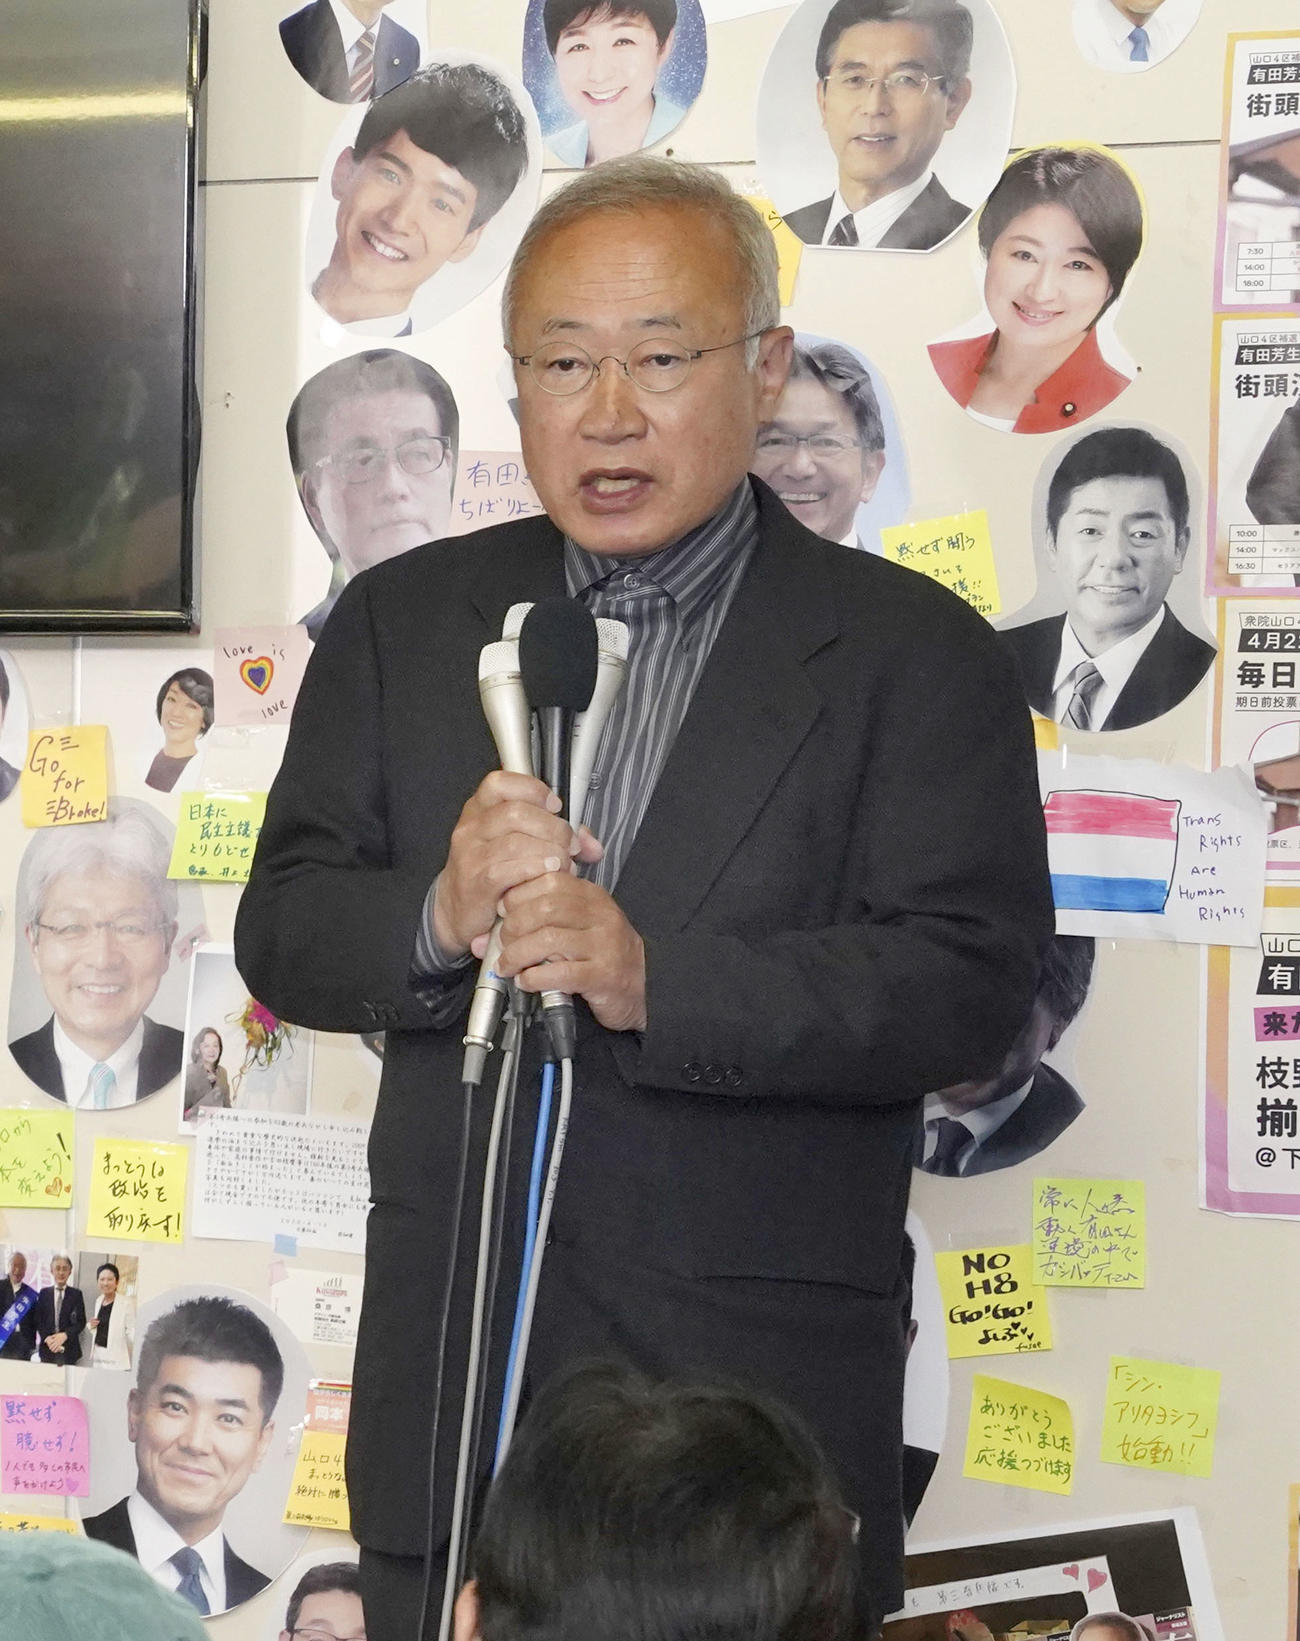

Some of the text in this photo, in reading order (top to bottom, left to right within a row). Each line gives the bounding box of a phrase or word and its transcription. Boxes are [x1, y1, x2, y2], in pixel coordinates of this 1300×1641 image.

[1244, 615, 1300, 627] 衆院山口
[1247, 632, 1300, 649] 4月2
[223, 643, 287, 660] love is
[261, 699, 288, 719] love
[29, 735, 60, 777] Go
[53, 769, 85, 793] for
[190, 803, 227, 820] 日本に
[1183, 813, 1222, 826] Trans
[1199, 835, 1242, 852] Rights
[1191, 866, 1216, 876] Are
[1179, 885, 1225, 898] Human
[1199, 906, 1245, 921] Rights
[1268, 963, 1300, 990] 有
[962, 1252, 1011, 1276] NO
[965, 1272, 1018, 1299] H8
[980, 1395, 1051, 1430] ありがとう
[983, 1424, 1072, 1453] ございました
